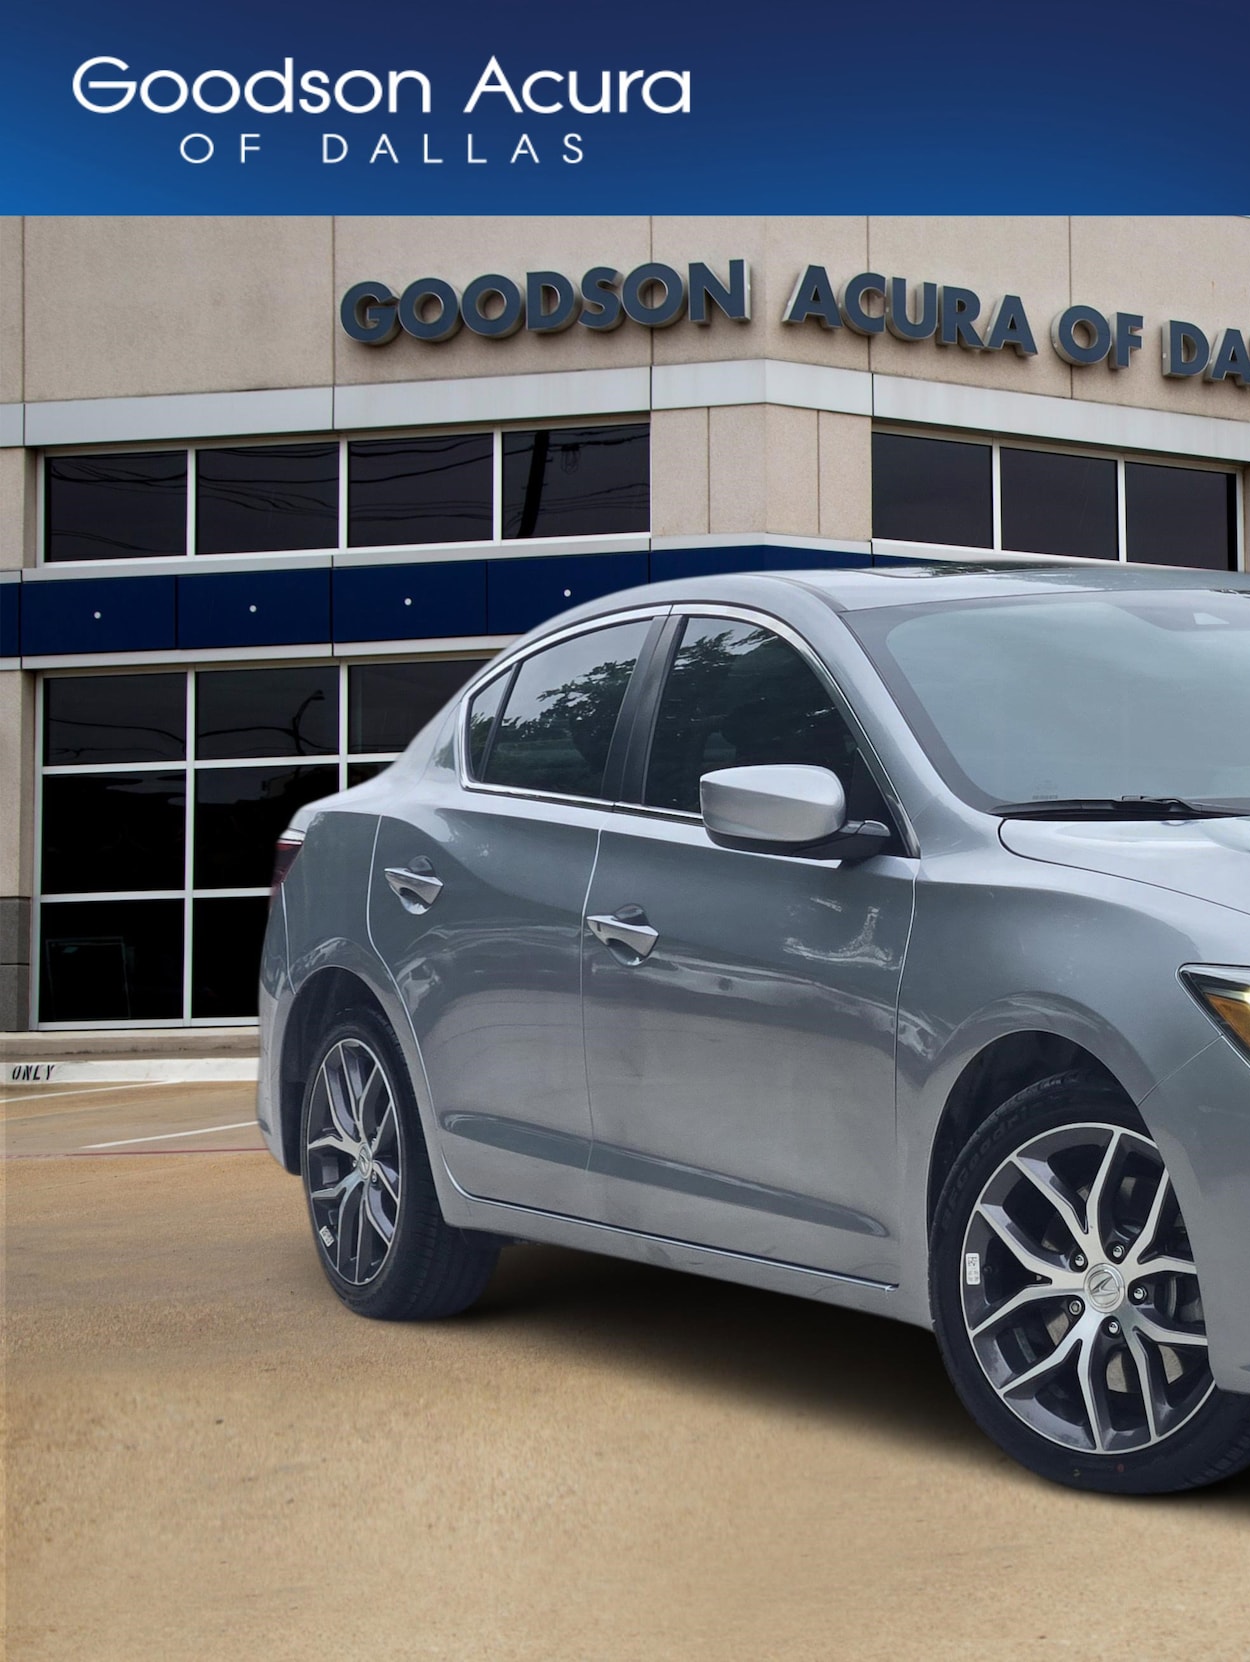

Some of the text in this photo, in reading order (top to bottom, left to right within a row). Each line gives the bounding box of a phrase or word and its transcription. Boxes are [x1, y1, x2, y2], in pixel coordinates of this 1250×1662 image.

[340, 259, 752, 346] GOODSON
[782, 264, 1038, 357] ACURA
[1050, 304, 1144, 367] OF
[12, 1064, 55, 1080] ONLY
